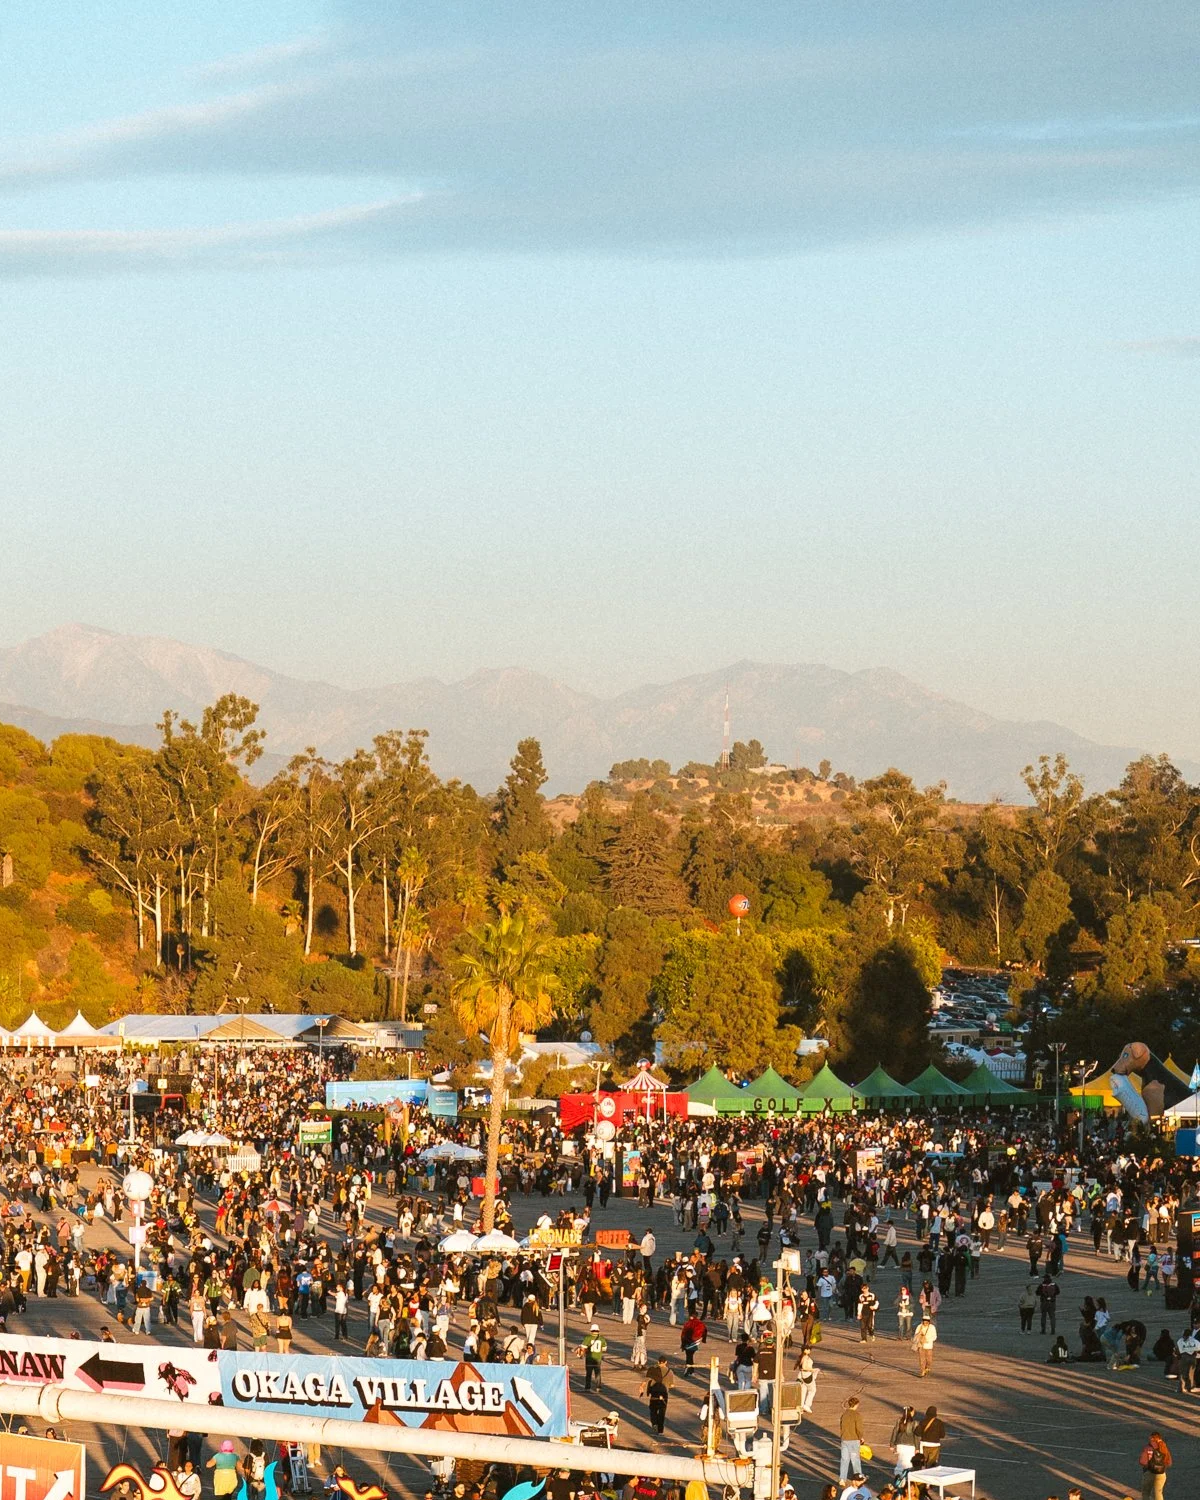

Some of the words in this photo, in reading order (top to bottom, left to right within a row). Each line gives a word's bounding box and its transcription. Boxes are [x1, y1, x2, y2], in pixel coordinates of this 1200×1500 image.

[753, 1097, 804, 1111] GOLF
[824, 1097, 834, 1112] X
[233, 1369, 354, 1406] OKAGA
[355, 1376, 506, 1411] VILLAGE
